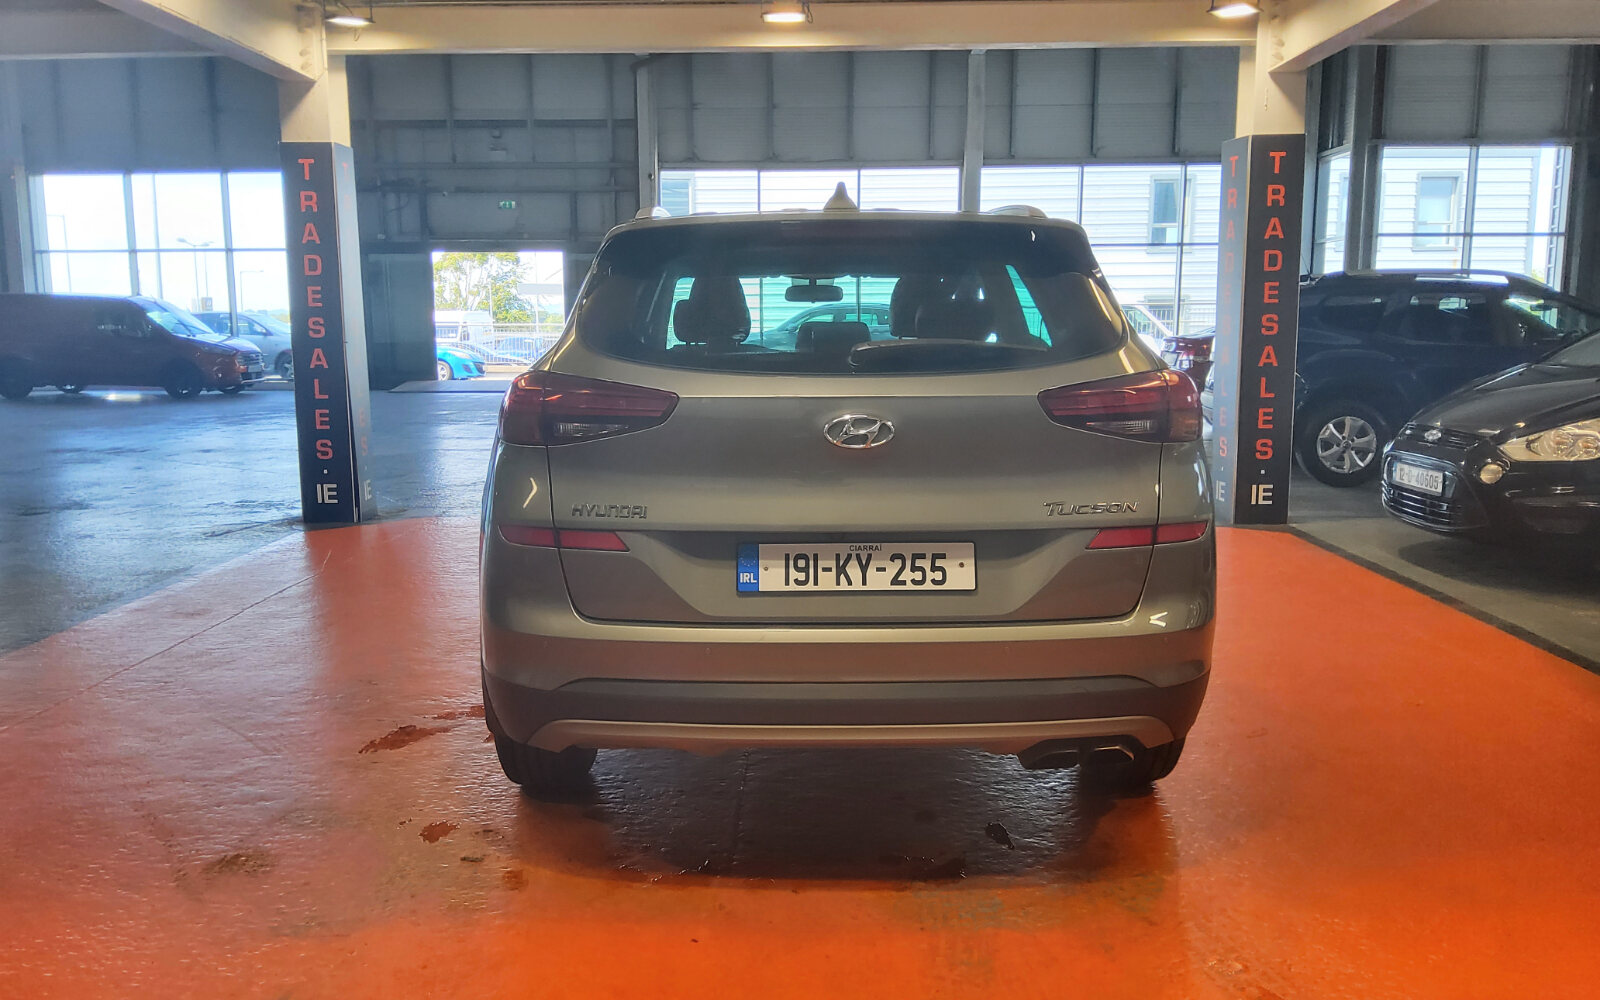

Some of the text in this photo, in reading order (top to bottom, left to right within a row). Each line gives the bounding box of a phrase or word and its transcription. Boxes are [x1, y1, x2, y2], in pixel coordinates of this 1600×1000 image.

[571, 503, 647, 519] HYUNDAI
[1043, 501, 1138, 516] TUCSON
[784, 552, 947, 587] 191-KY-255
[740, 572, 757, 583] IRL
